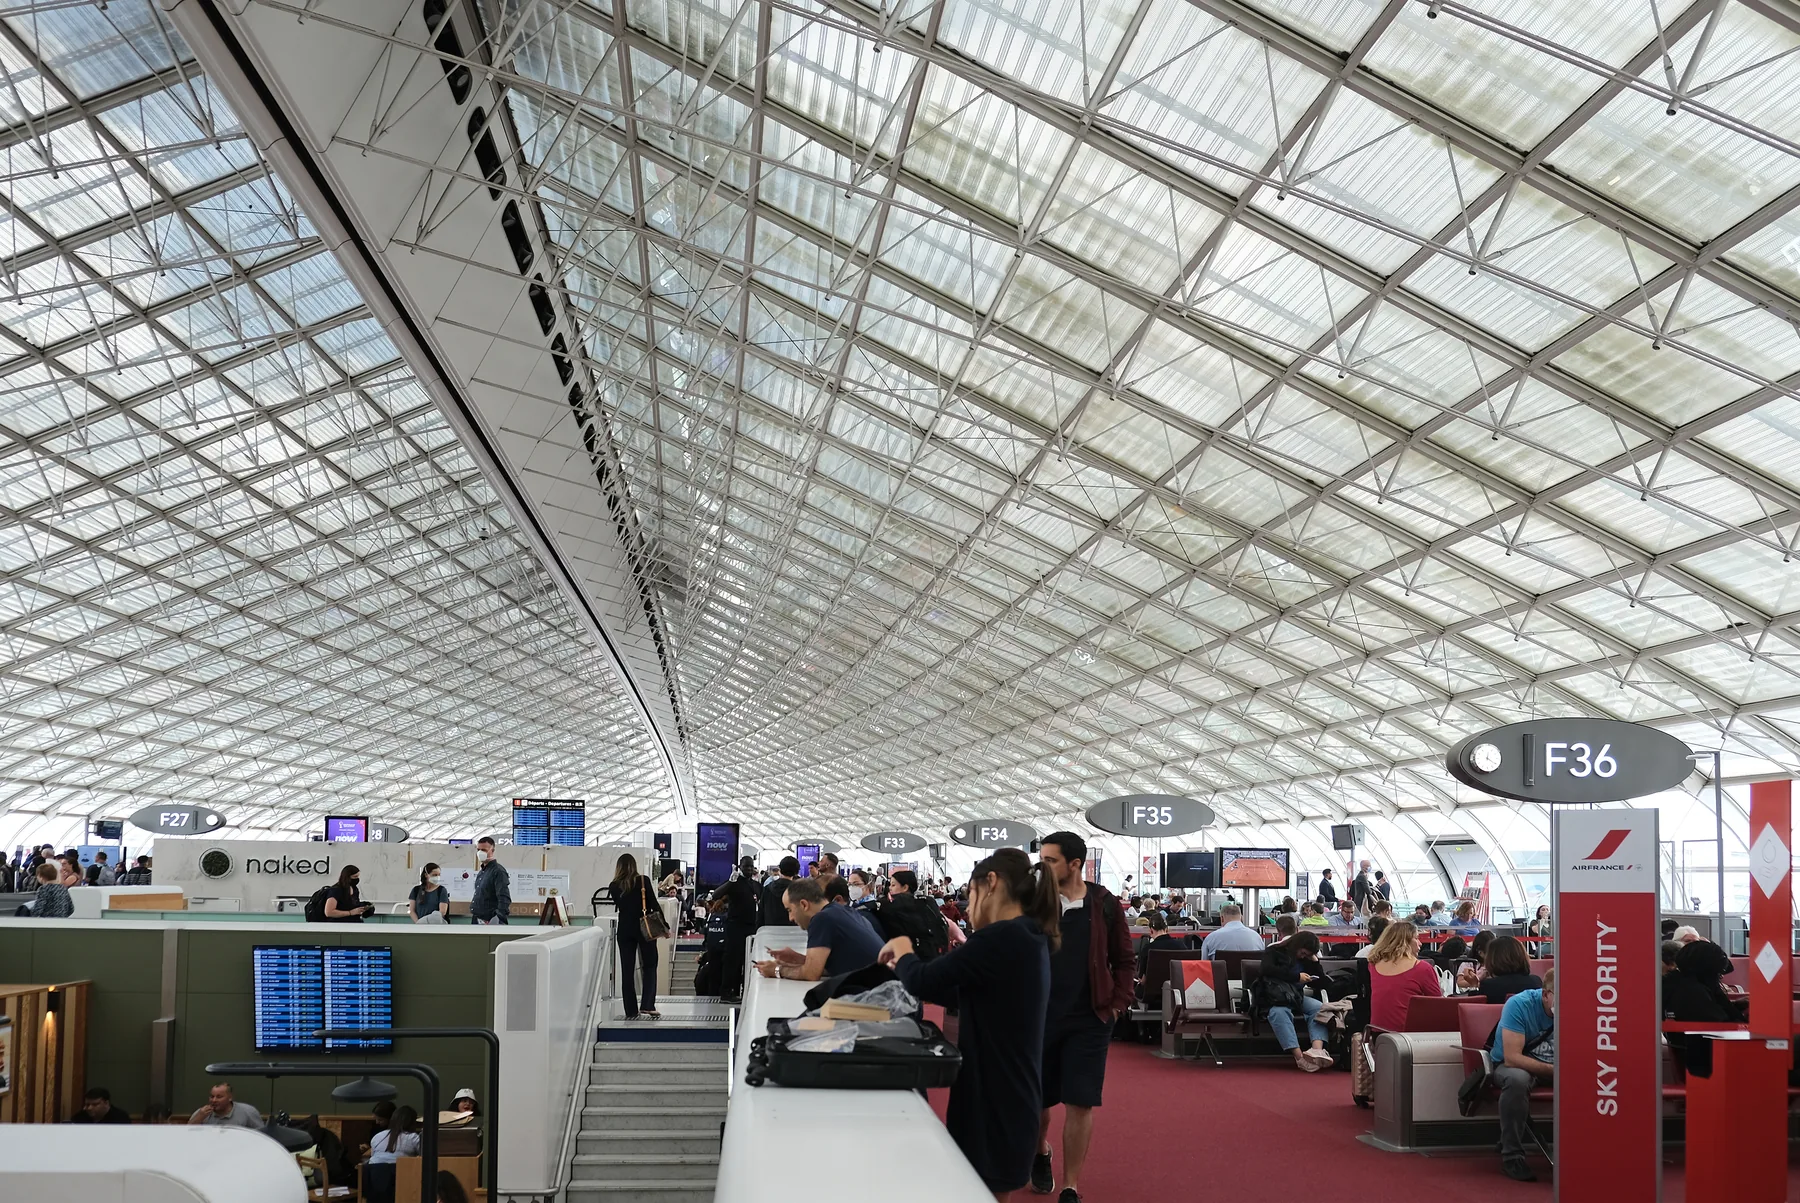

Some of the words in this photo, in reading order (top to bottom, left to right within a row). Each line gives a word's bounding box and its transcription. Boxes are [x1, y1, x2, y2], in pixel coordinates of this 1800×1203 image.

[1545, 743, 1617, 777] F36
[160, 813, 189, 827] F27
[1133, 806, 1172, 826] F35
[884, 836, 905, 849] F33
[981, 827, 1008, 841] F34
[246, 855, 330, 875] naked
[1596, 920, 1618, 1051] PRIORITY
[1596, 1060, 1618, 1116] SKY
